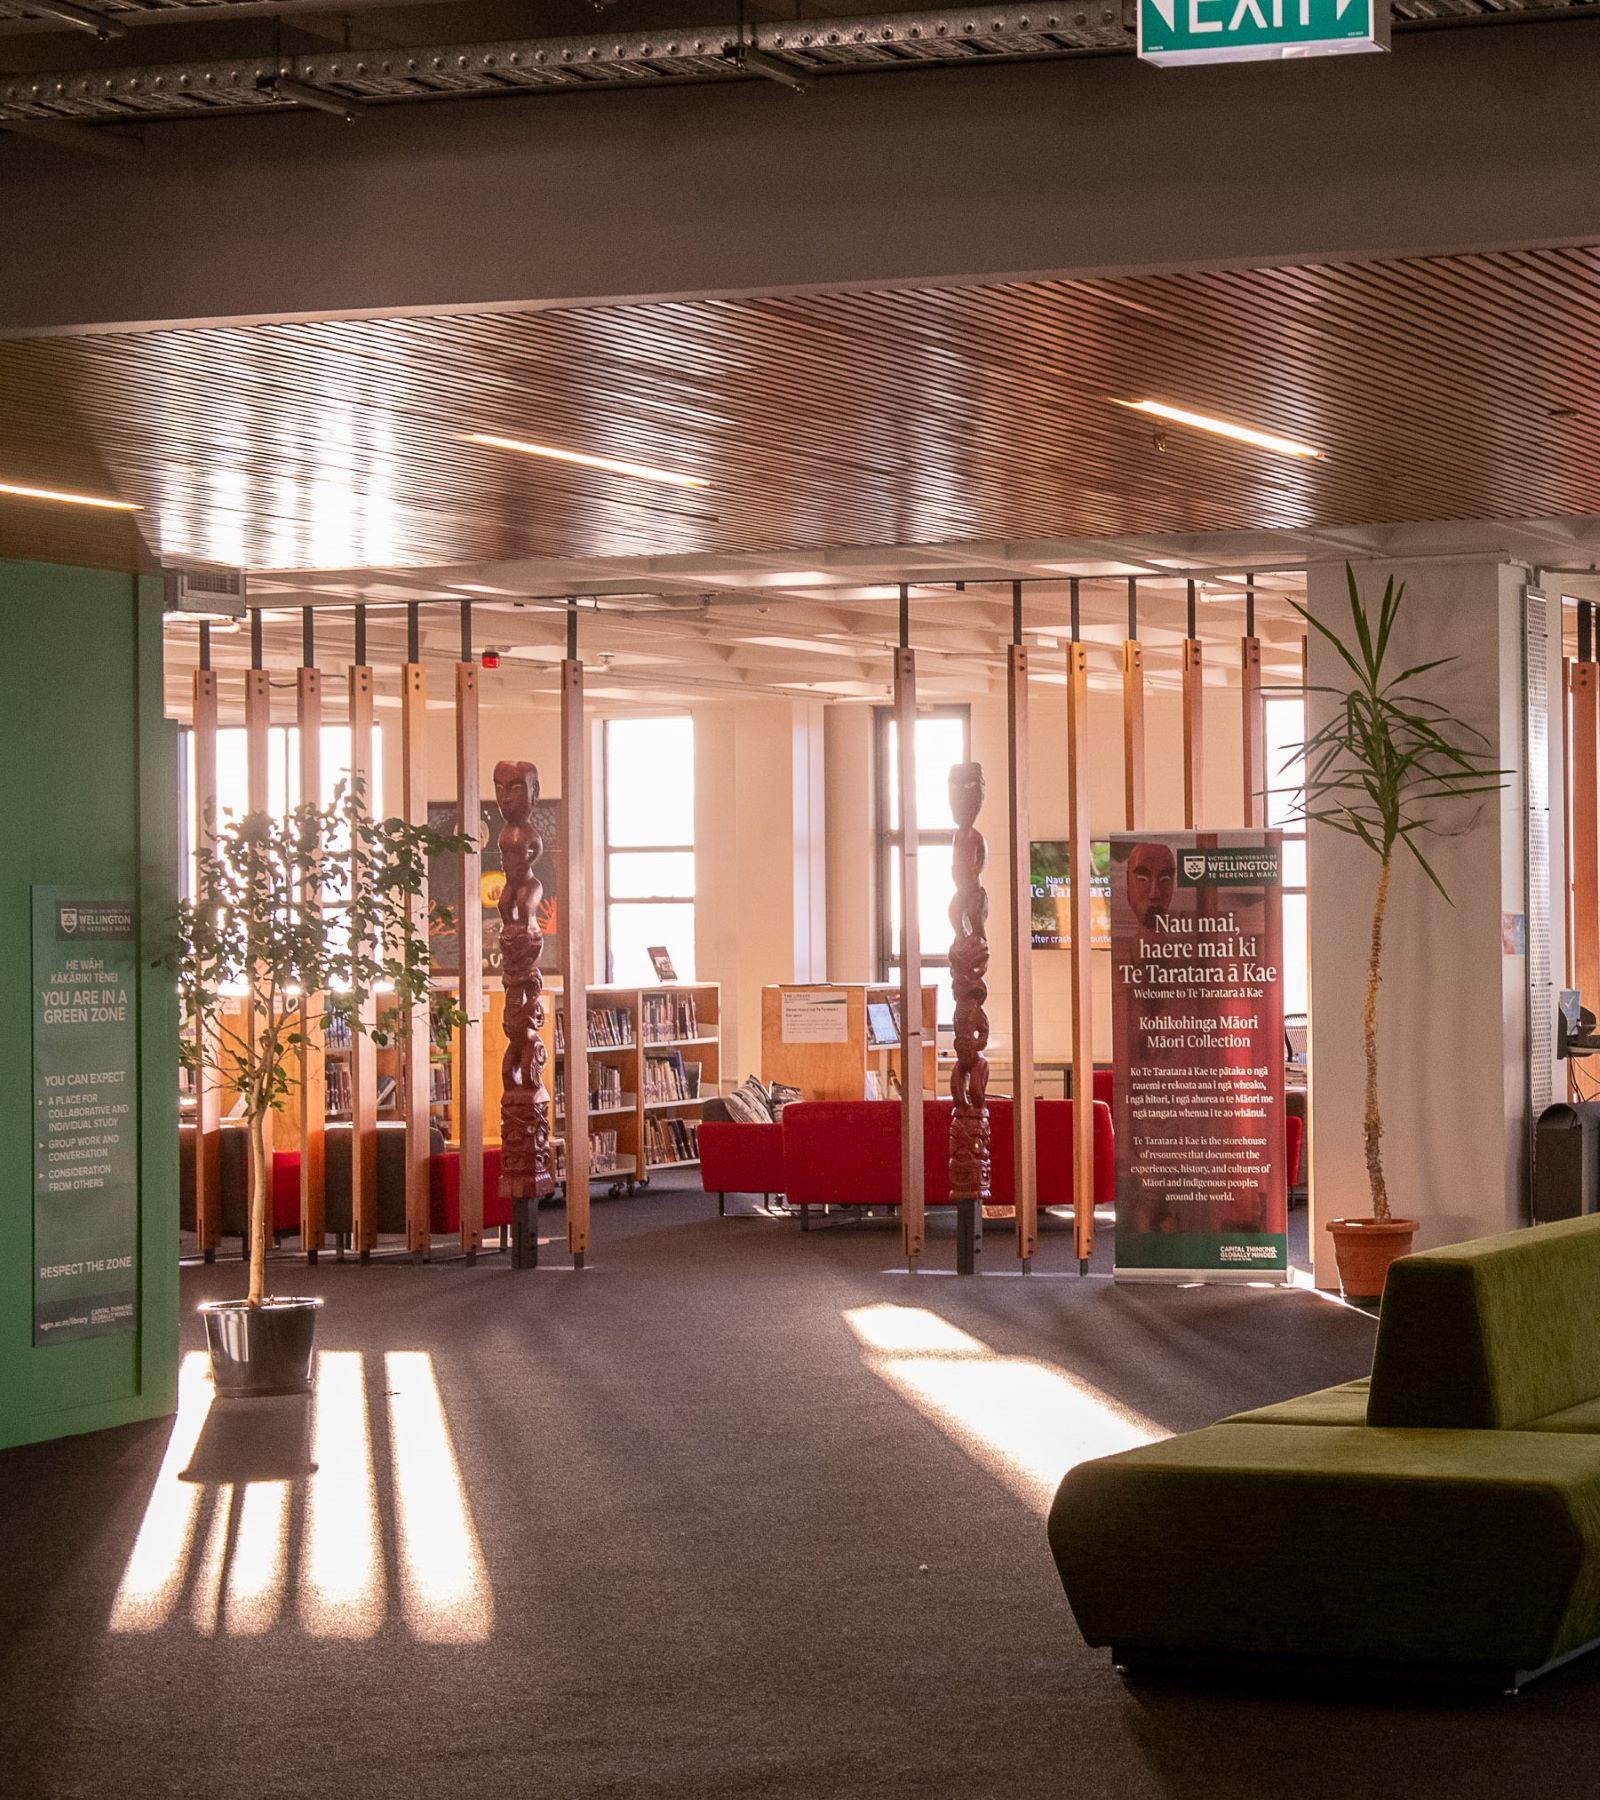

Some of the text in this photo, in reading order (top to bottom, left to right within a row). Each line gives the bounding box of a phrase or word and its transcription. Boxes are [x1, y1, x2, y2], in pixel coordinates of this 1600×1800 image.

[1208, 861, 1278, 871] WELLINGTON
[1046, 875, 1063, 884] Nau
[79, 915, 131, 925] WELLINGTON
[1155, 912, 1240, 935] Nau mai,
[1140, 937, 1256, 958] haere mai ki
[66, 957, 104, 970] HE WĀHI
[51, 970, 118, 984] KĀKĀRIKI TĒNEI
[1120, 963, 1277, 984] Te Taratara ā Kae
[42, 989, 128, 1006] YOU ARE IN A
[1134, 988, 1263, 999] Welcome to Te Taratara ā Kae
[44, 1007, 125, 1024] GREEN ZONE
[1140, 1015, 1258, 1032] Kohikohinga Māori
[1147, 1034, 1251, 1048] Māori Collection
[44, 1071, 126, 1087] YOU CAN EXPECT
[1130, 1067, 1141, 1076] Ko
[1142, 1067, 1152, 1076] Te
[1153, 1067, 1187, 1076] Taratara
[1194, 1067, 1209, 1076] Kae
[1209, 1067, 1218, 1076] te
[1219, 1066, 1246, 1078] pātaka
[1254, 1066, 1268, 1077] ngā
[1132, 1080, 1160, 1090] rauemi
[1168, 1080, 1197, 1090] rekoata
[1198, 1082, 1212, 1090] ana
[1218, 1081, 1232, 1092] ngā
[1233, 1079, 1267, 1090] wheako,
[48, 1094, 98, 1106] A PLACE FOR
[1130, 1095, 1144, 1105] ngā
[1145, 1094, 1170, 1104] hitori,
[1176, 1094, 1190, 1105] ngā
[1191, 1094, 1218, 1104] ahurea
[1226, 1095, 1234, 1103] te
[1235, 1094, 1259, 1103] Māori
[1260, 1095, 1274, 1103] me
[48, 1104, 129, 1119] COLLABORATIVE AND
[1133, 1109, 1147, 1119] ngā
[1148, 1110, 1177, 1119] tangata
[1179, 1108, 1209, 1118] whenua
[1214, 1109, 1222, 1117] te
[1234, 1107, 1267, 1117] whānui.
[48, 1118, 119, 1132] INDIVIDUAL STUDY
[48, 1134, 120, 1149] GROUP WORK AND
[1133, 1136, 1143, 1145] Te
[1144, 1136, 1178, 1145] Taratara
[1185, 1136, 1200, 1145] Kae
[1201, 1136, 1208, 1145] is
[1209, 1136, 1221, 1145] the
[1223, 1136, 1267, 1145] storehouse
[48, 1148, 108, 1162] CONVERSATION
[1140, 1149, 1149, 1159] of
[1188, 1150, 1204, 1159] that
[1205, 1150, 1245, 1159] document
[1246, 1150, 1260, 1159] the
[48, 1165, 111, 1179] CONSIDERATION
[1130, 1163, 1271, 1175] experiences, history, and cultures of
[49, 1178, 104, 1192] FROM OTHERS
[1142, 1178, 1258, 1189] Māori and indigenous peoples
[1165, 1191, 1235, 1201] around the world.
[40, 1256, 132, 1279] RESPECT THE ZONE
